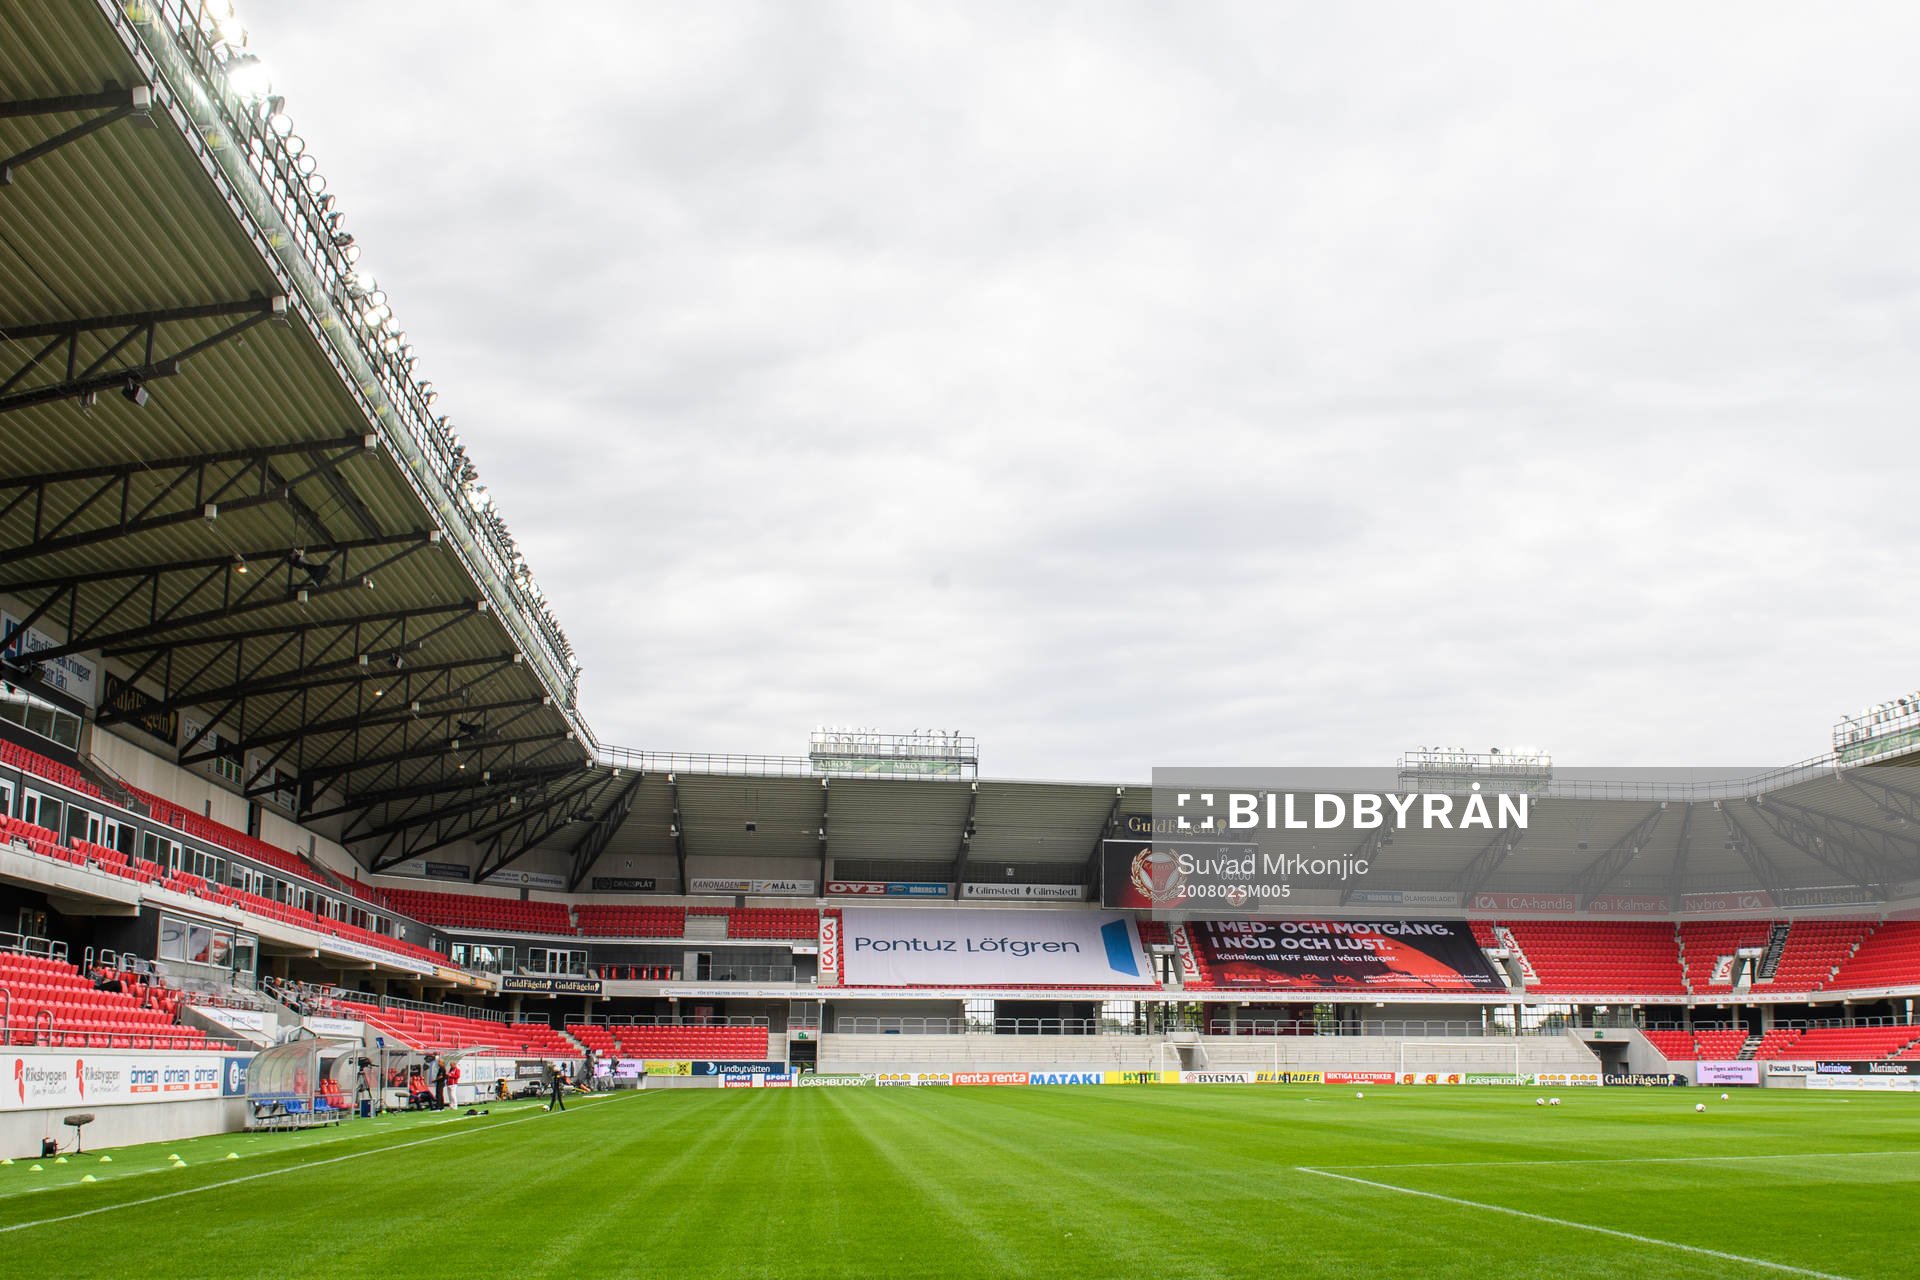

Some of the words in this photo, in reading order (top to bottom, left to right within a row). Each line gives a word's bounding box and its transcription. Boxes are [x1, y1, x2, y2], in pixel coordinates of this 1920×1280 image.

[692, 880, 740, 889] KANONADEN
[771, 881, 798, 890] MÅLA
[828, 884, 885, 894] OVE
[976, 886, 1020, 896] Glimstedt
[1033, 886, 1077, 897] Glimstedt
[1475, 896, 1498, 909] ICA
[1617, 899, 1657, 911] Kalmar
[1685, 897, 1726, 911] Nybro
[1738, 896, 1762, 908] ICA
[822, 921, 834, 944] ICA
[1280, 922, 1330, 934] OCH
[1332, 920, 1455, 936] MOTGÅNG.
[855, 937, 957, 952] Pontuz
[966, 937, 1080, 957] Löfgren
[1210, 936, 1219, 948] I
[1222, 934, 1276, 949] NÖD
[1280, 937, 1332, 950] OCH
[1334, 938, 1392, 951] LUST.
[822, 946, 835, 970] ICA
[1216, 953, 1265, 961] Kärleken
[1266, 953, 1279, 961] till
[1280, 953, 1301, 961] KFF
[1337, 954, 1363, 962] våra
[505, 978, 547, 990] GuldFågeln
[555, 980, 596, 991] GuldFågeln
[719, 1064, 771, 1075] Lindbytvätten
[1817, 1062, 1852, 1074] Matinique
[1869, 1062, 1908, 1075] Matinique
[801, 1078, 866, 1087] CASHBUDDY
[955, 1073, 990, 1083] renta
[992, 1073, 1026, 1083] renta
[1030, 1073, 1101, 1085] MATAKI
[1198, 1074, 1246, 1083] BYGMA
[1605, 1074, 1668, 1087] GuldFågeln
